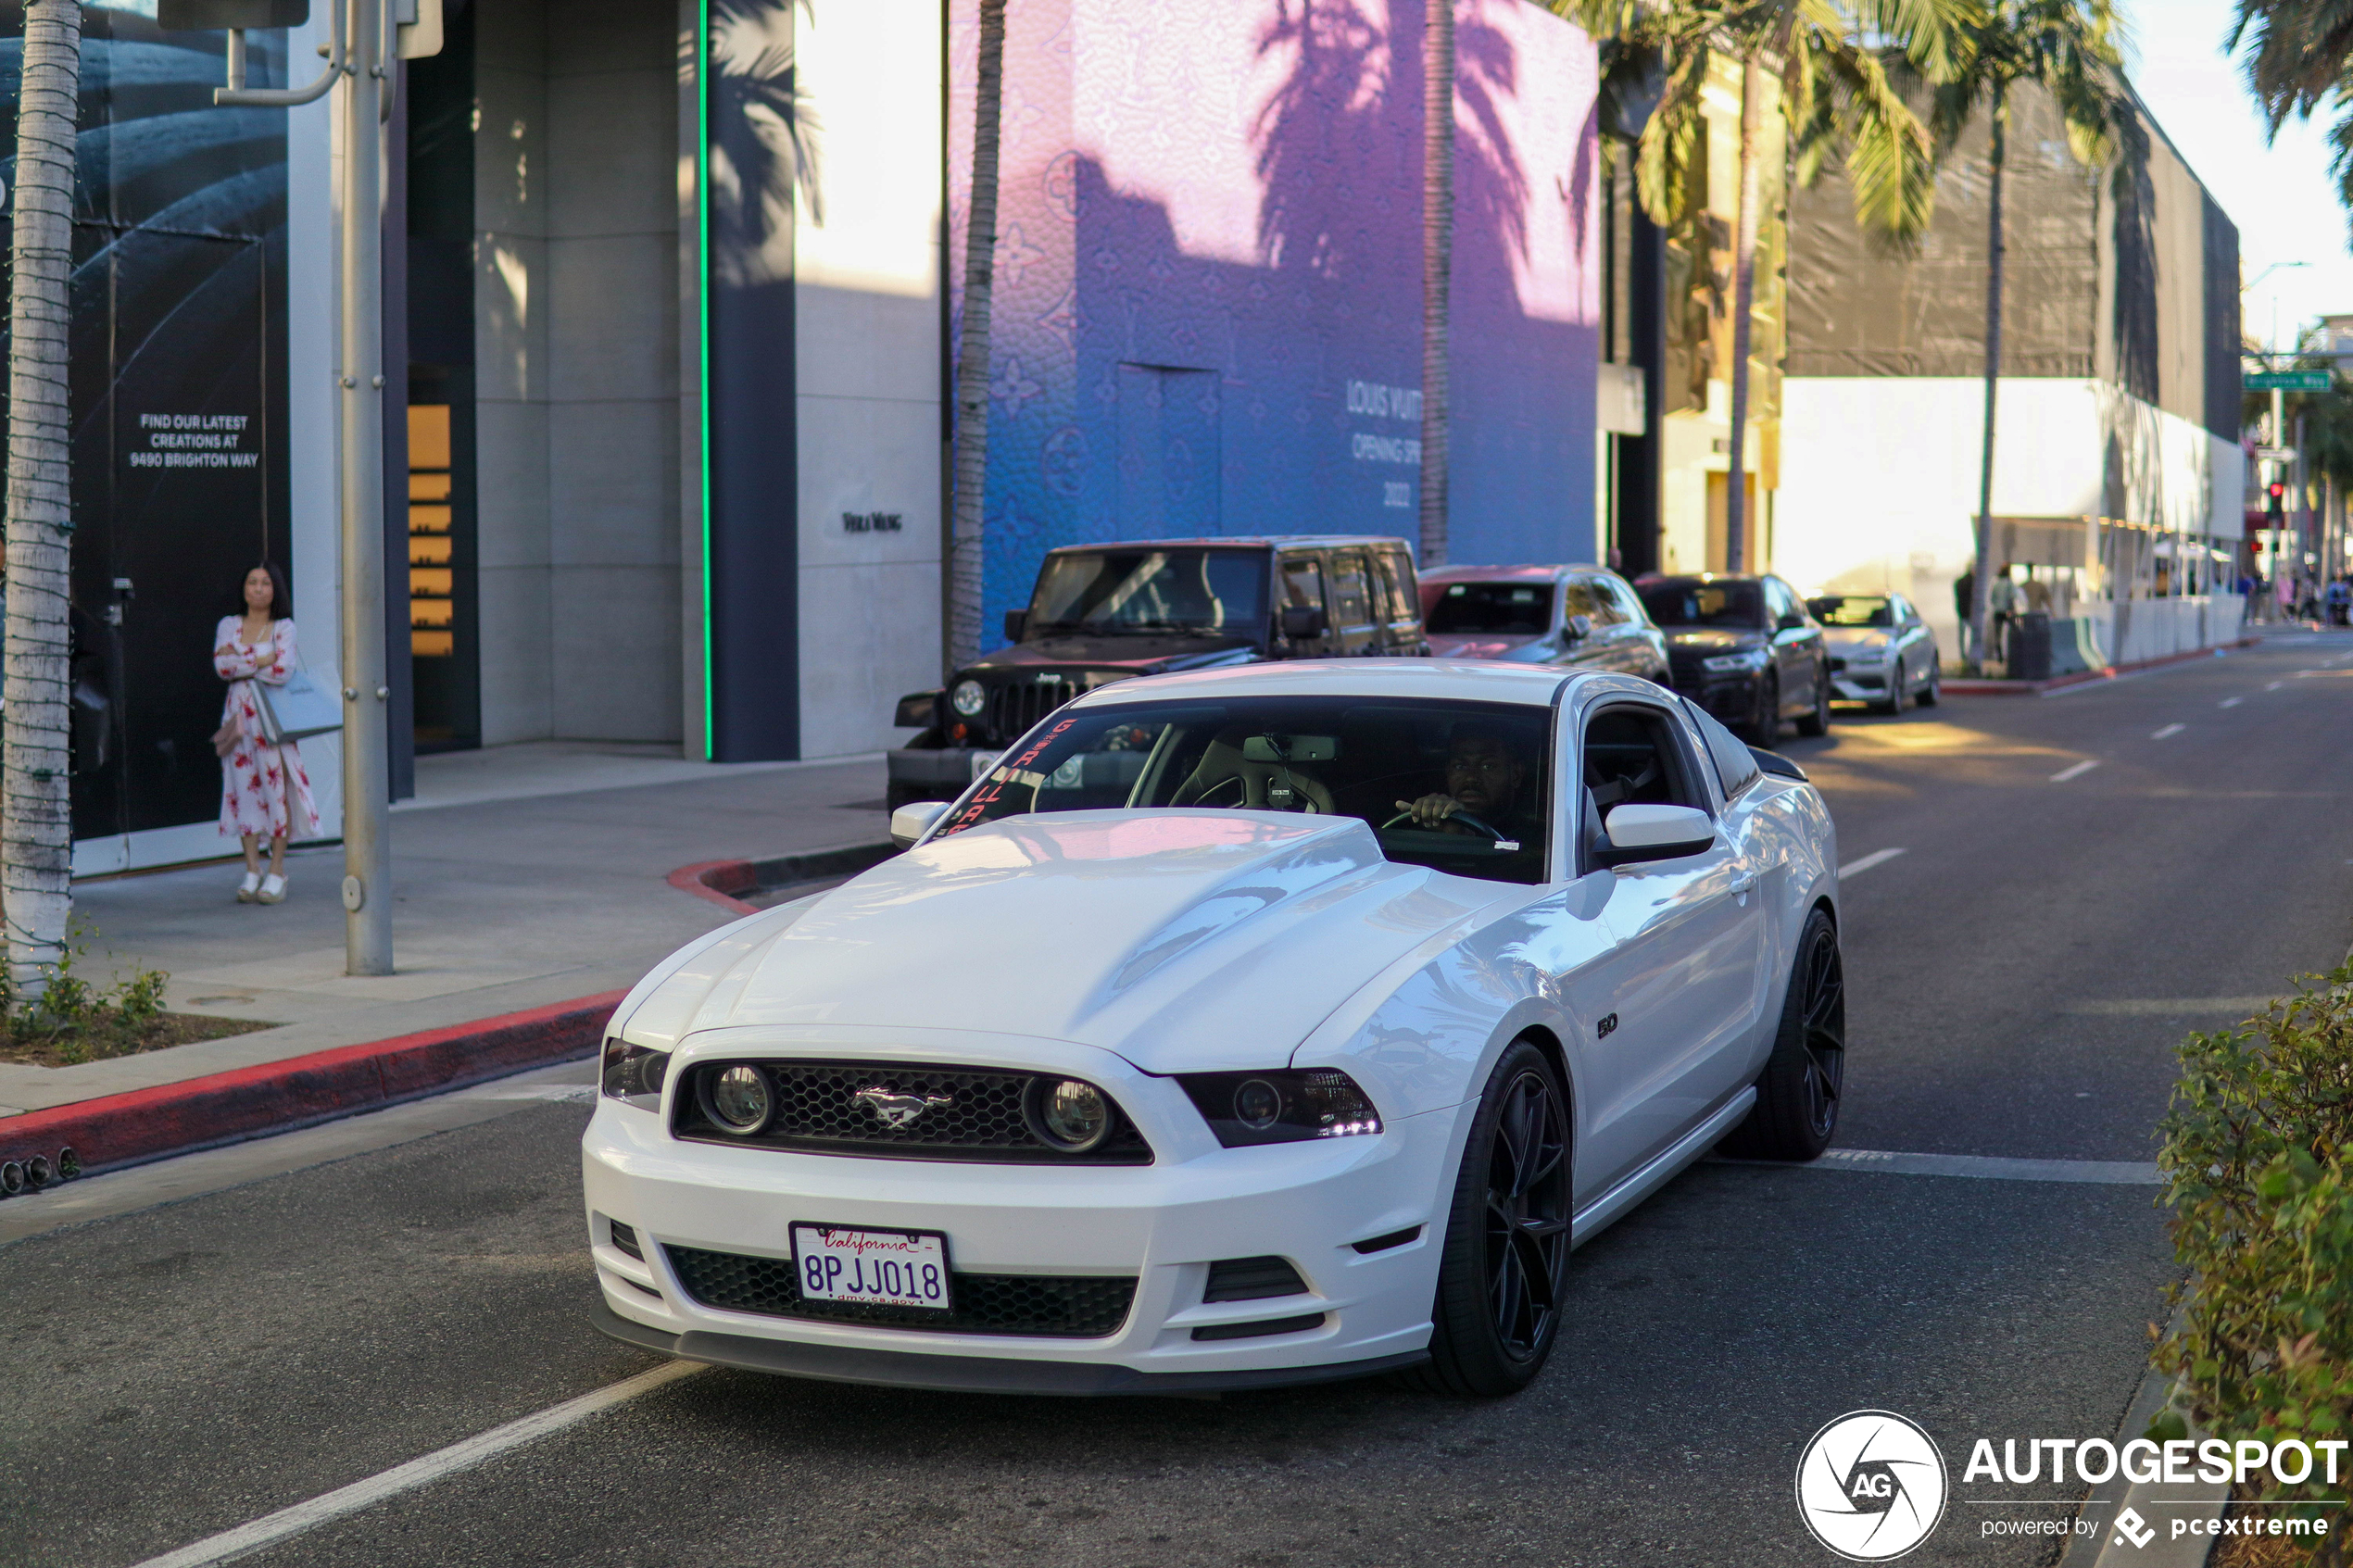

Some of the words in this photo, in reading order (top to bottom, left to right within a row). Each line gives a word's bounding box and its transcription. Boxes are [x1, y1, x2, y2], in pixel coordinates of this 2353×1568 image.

[1348, 381, 1388, 417] LOUIS
[141, 413, 171, 429] FIND
[173, 414, 201, 430] OUR
[203, 415, 248, 431] LATEST
[151, 433, 221, 449] CREATIONS
[223, 433, 239, 449] AT
[131, 452, 163, 468] 9490
[165, 452, 228, 468] BRIGHTON
[230, 453, 258, 468] WAY
[1036, 672, 1062, 684] Jeep
[825, 1229, 919, 1255] California
[804, 1254, 940, 1300] 8PJJ018
[837, 1294, 915, 1306] dmv.ca.gov
